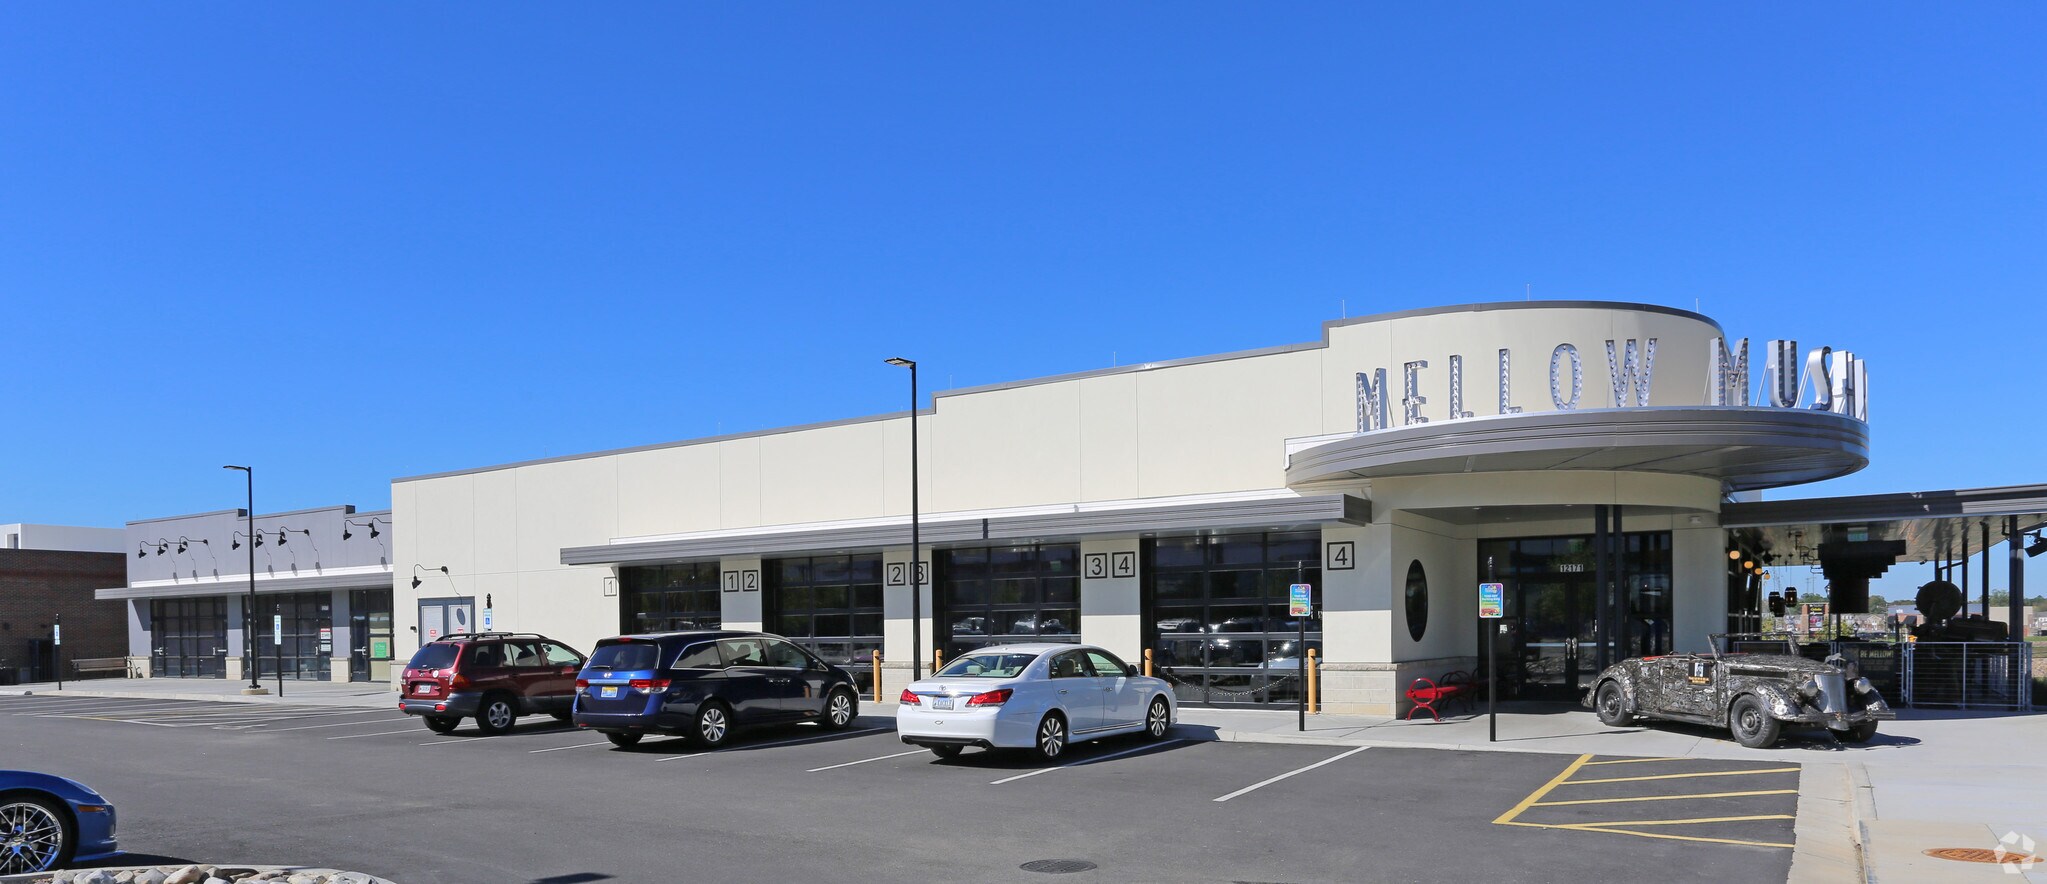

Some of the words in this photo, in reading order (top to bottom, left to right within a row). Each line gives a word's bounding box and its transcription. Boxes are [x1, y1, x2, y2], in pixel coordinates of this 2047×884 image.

[1356, 338, 1658, 433] MELLOW
[1118, 555, 1130, 574] 4
[1334, 545, 1348, 566] 4
[892, 566, 902, 583] 2
[1091, 557, 1103, 576] 3
[728, 574, 735, 589] 1
[747, 573, 756, 589] 2
